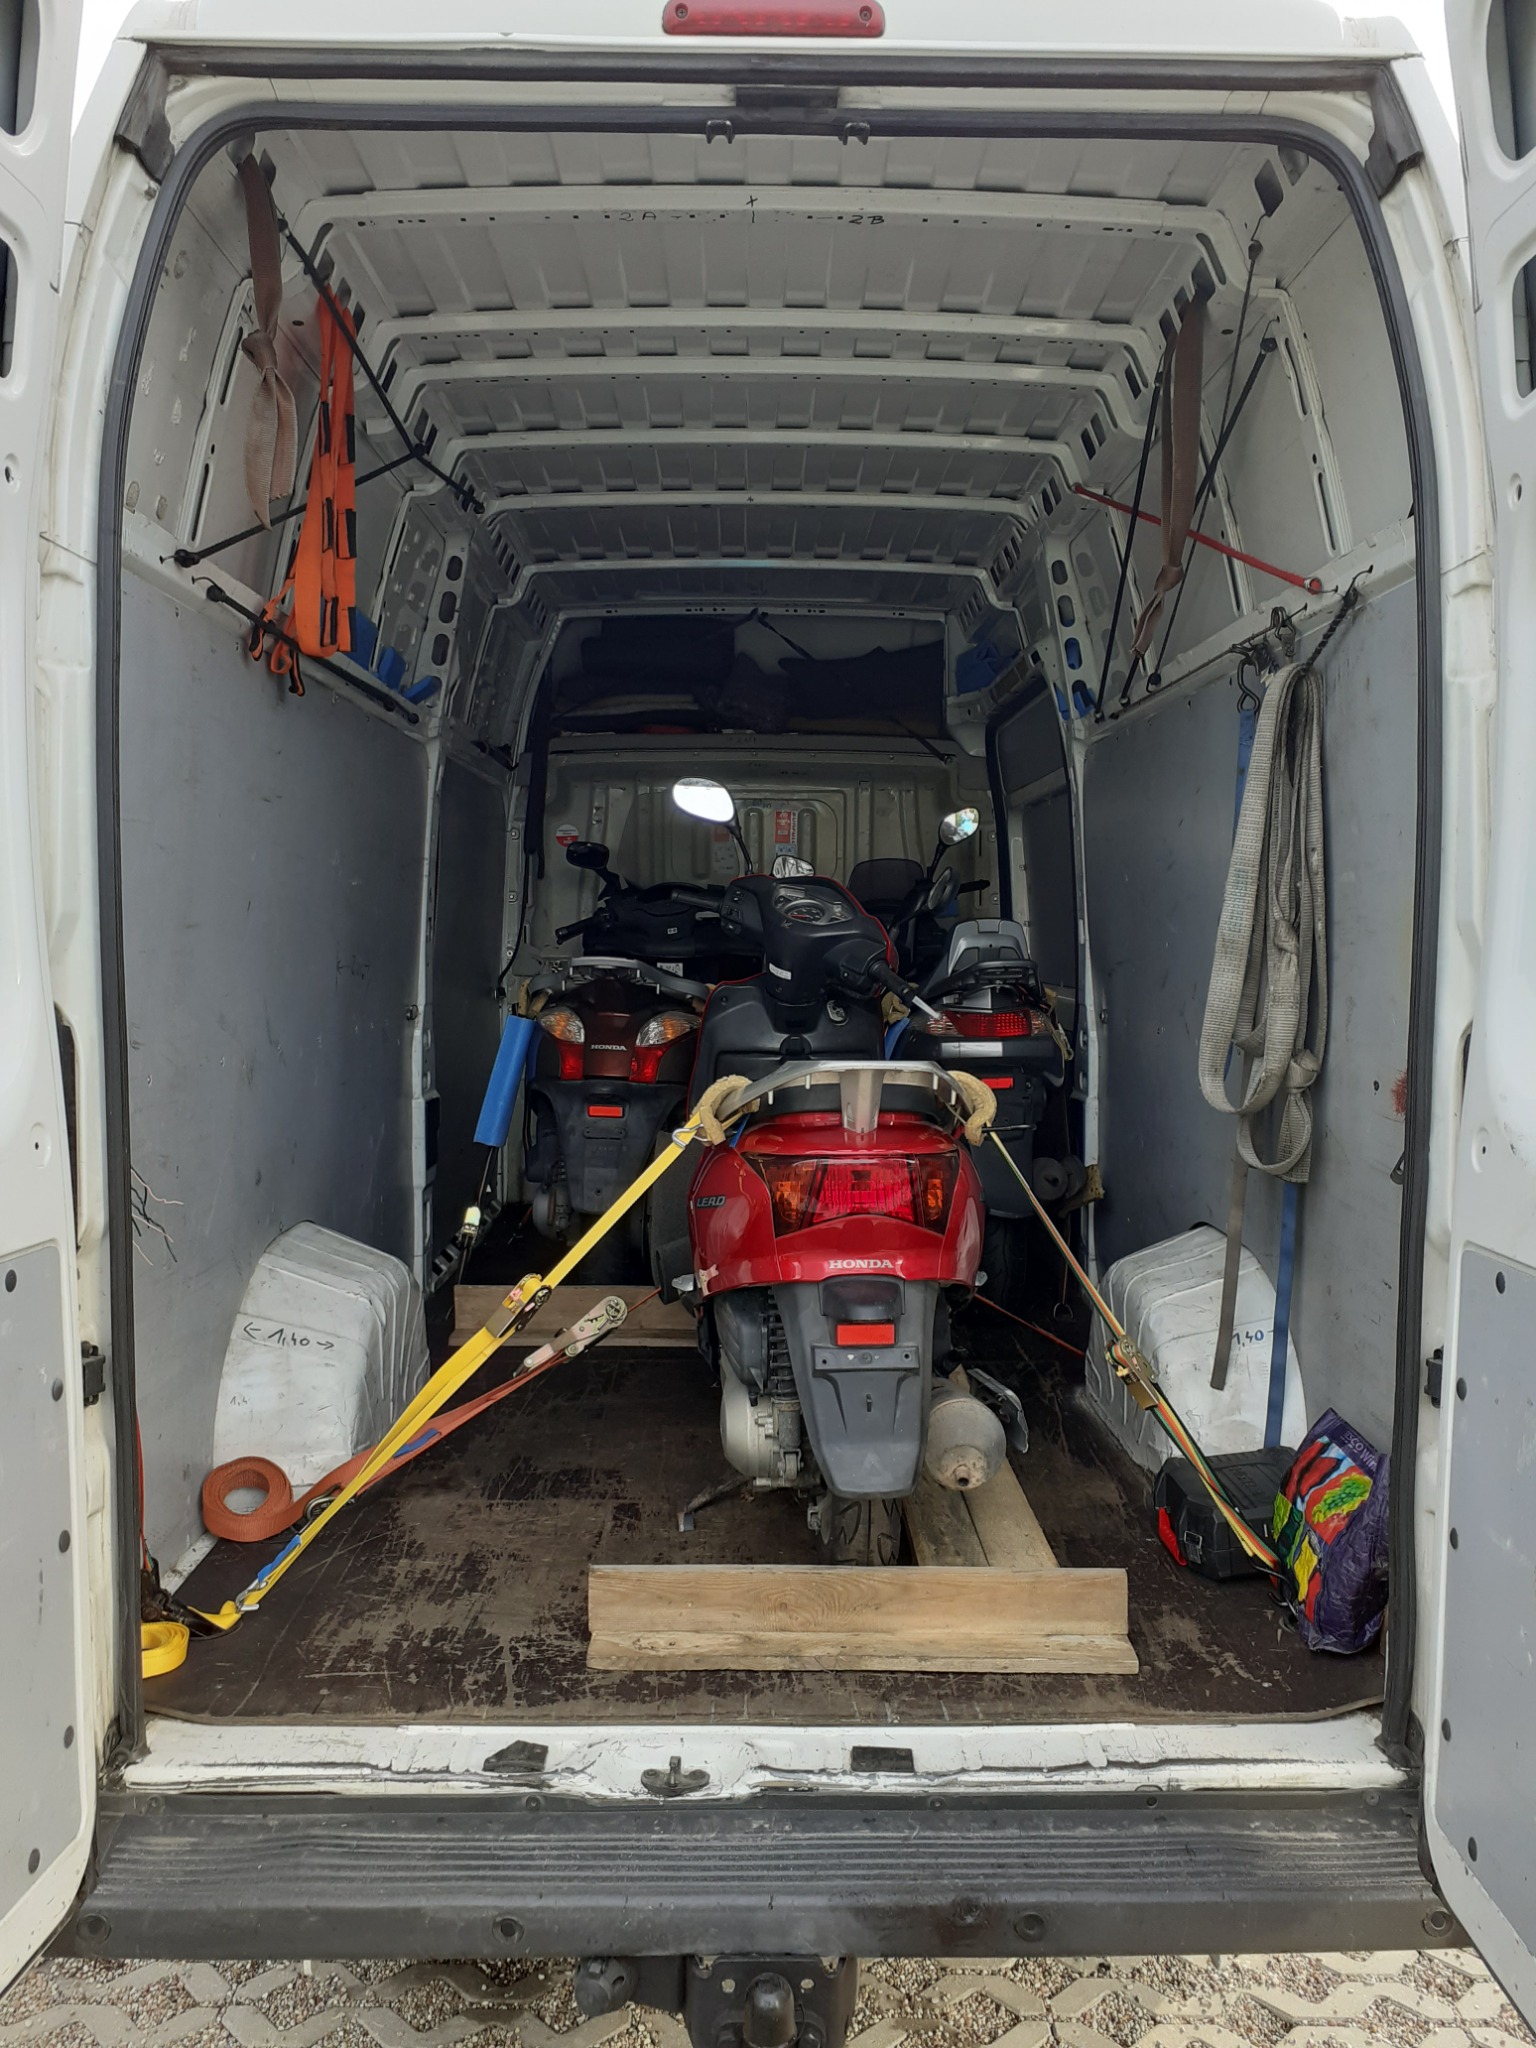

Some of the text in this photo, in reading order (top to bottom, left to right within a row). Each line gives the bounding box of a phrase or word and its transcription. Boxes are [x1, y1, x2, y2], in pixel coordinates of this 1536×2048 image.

[697, 1195, 726, 1208] LEAD
[828, 1259, 895, 1269] HONDA
[267, 1328, 311, 1347] 1,40
